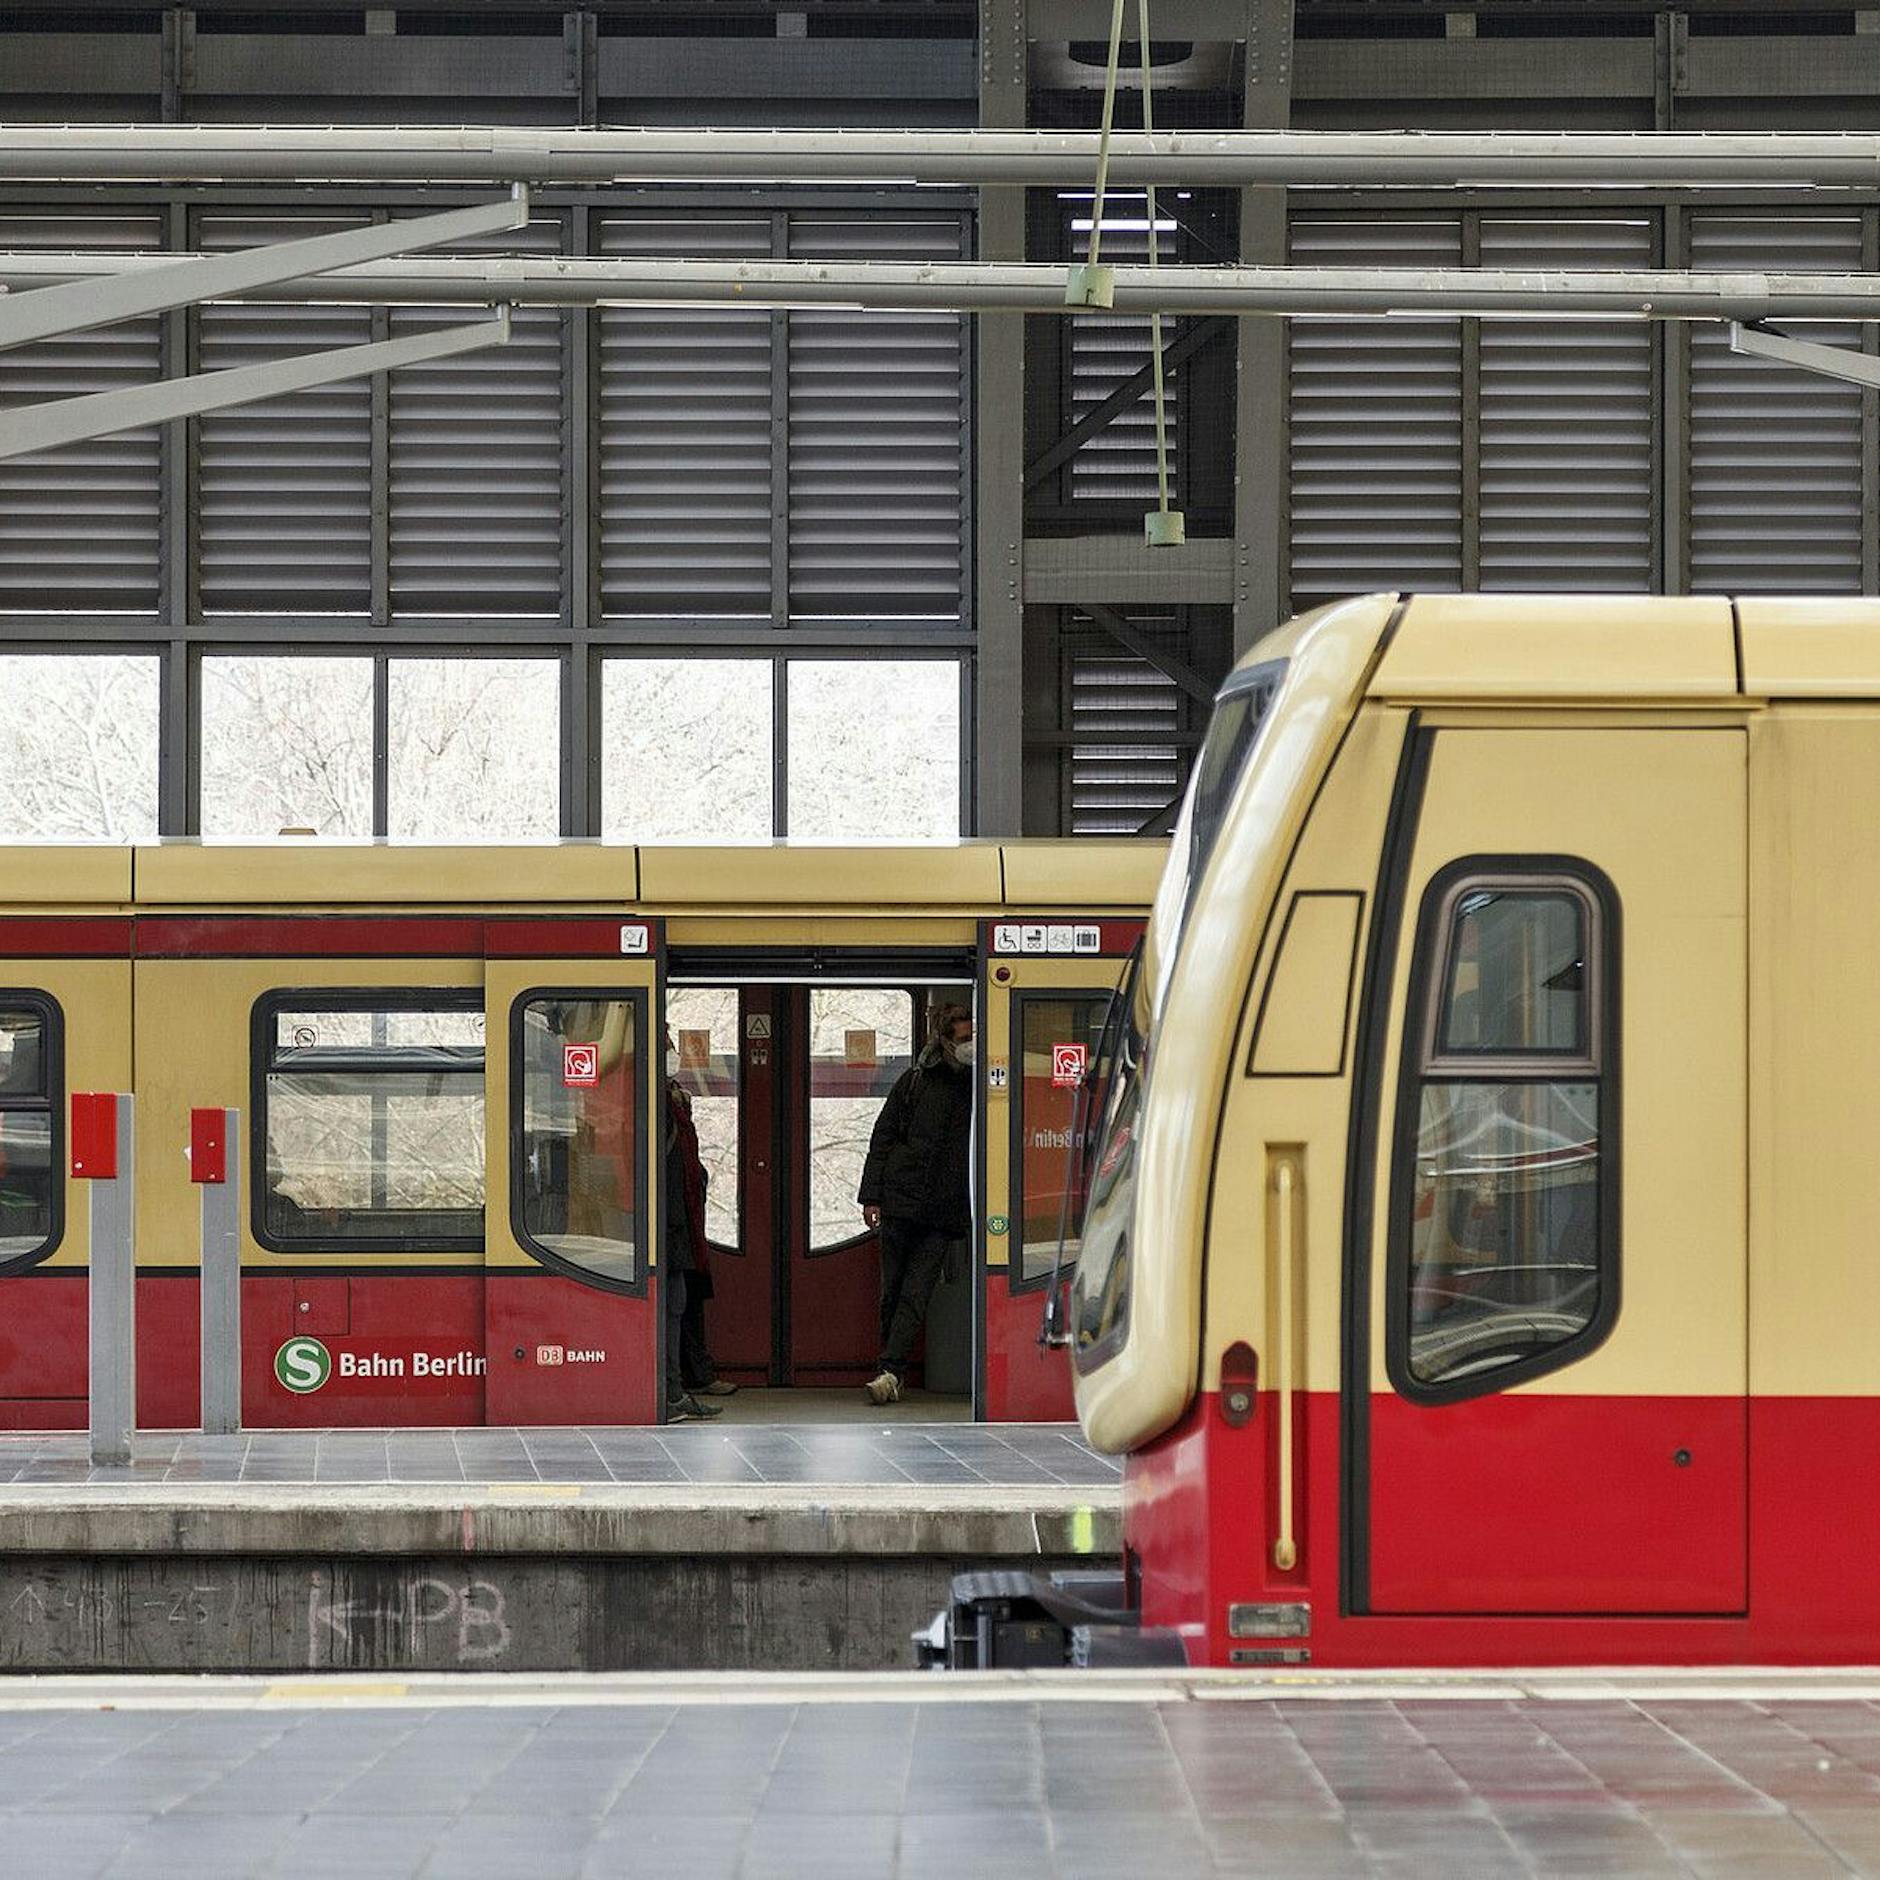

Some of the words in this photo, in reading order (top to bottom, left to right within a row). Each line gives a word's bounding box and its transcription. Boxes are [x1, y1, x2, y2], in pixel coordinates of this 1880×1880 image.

[285, 1343, 322, 1388] S
[339, 1352, 404, 1377] Bahn
[412, 1351, 487, 1377] Berlin
[567, 1350, 606, 1363] BAHN
